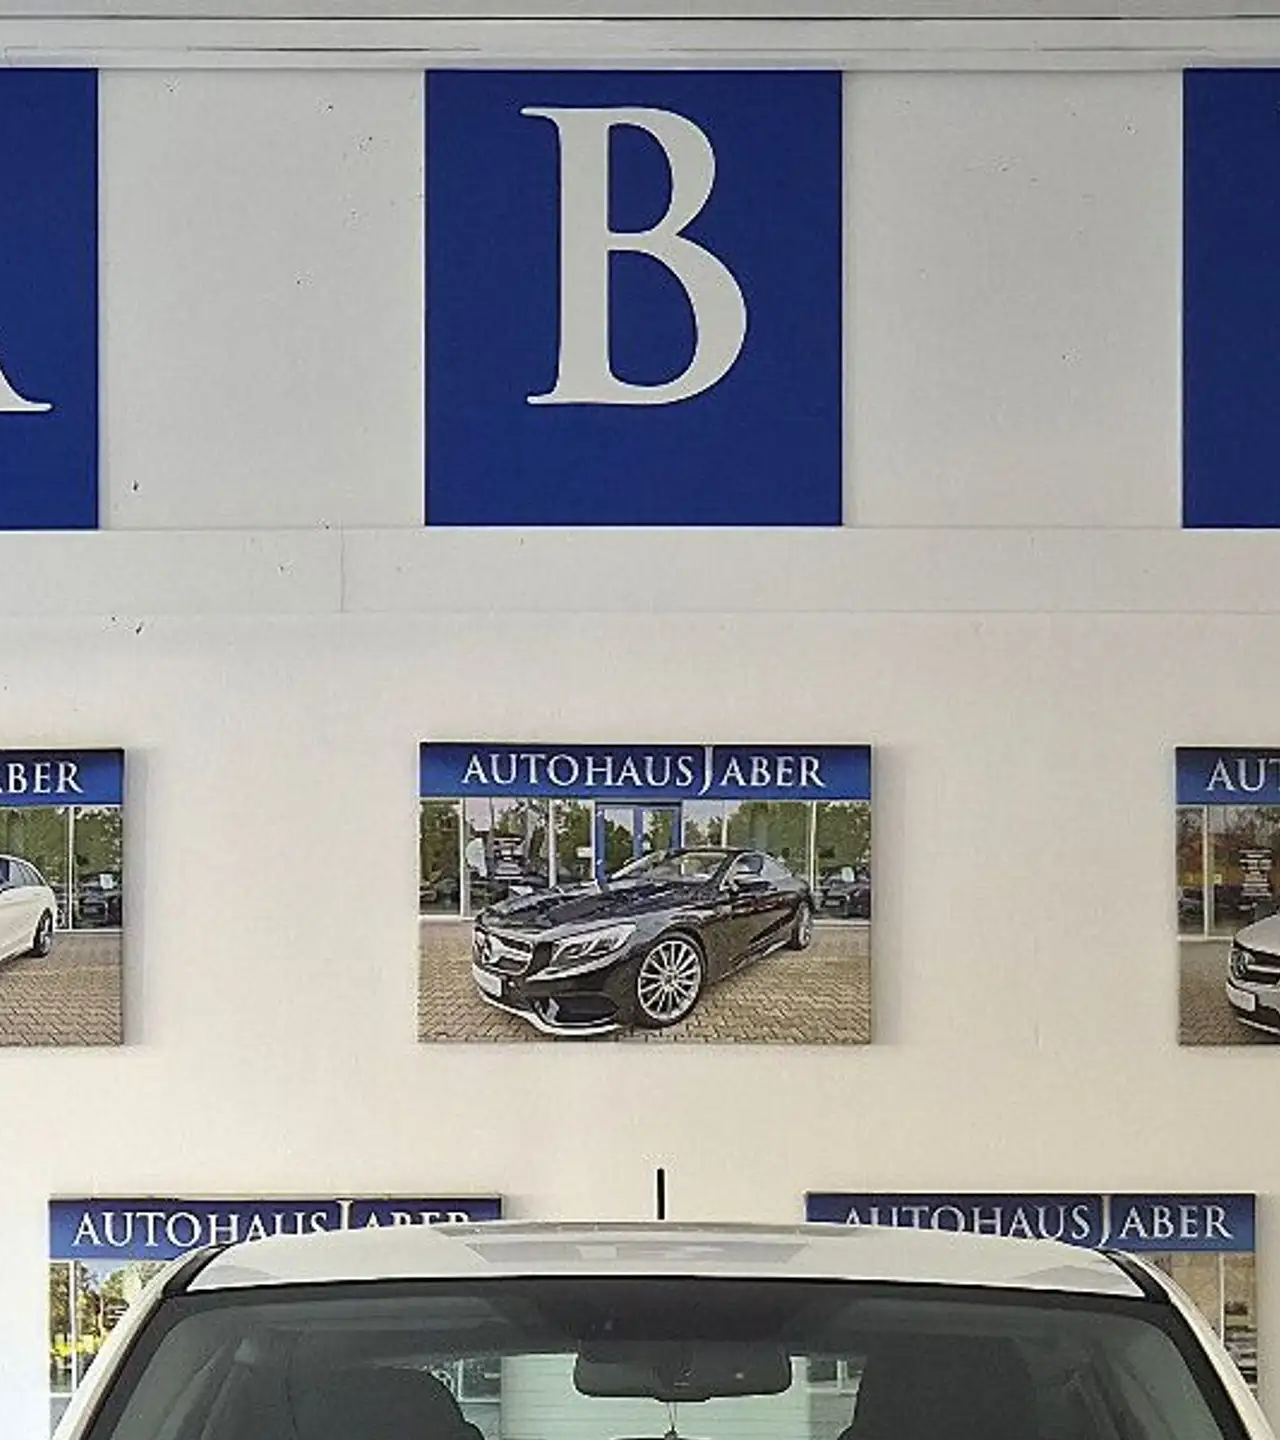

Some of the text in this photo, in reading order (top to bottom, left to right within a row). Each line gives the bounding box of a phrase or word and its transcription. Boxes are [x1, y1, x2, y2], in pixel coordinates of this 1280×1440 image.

[462, 746, 828, 797] AUTOHAUS JABER
[1096, 1195, 1235, 1248] JABER
